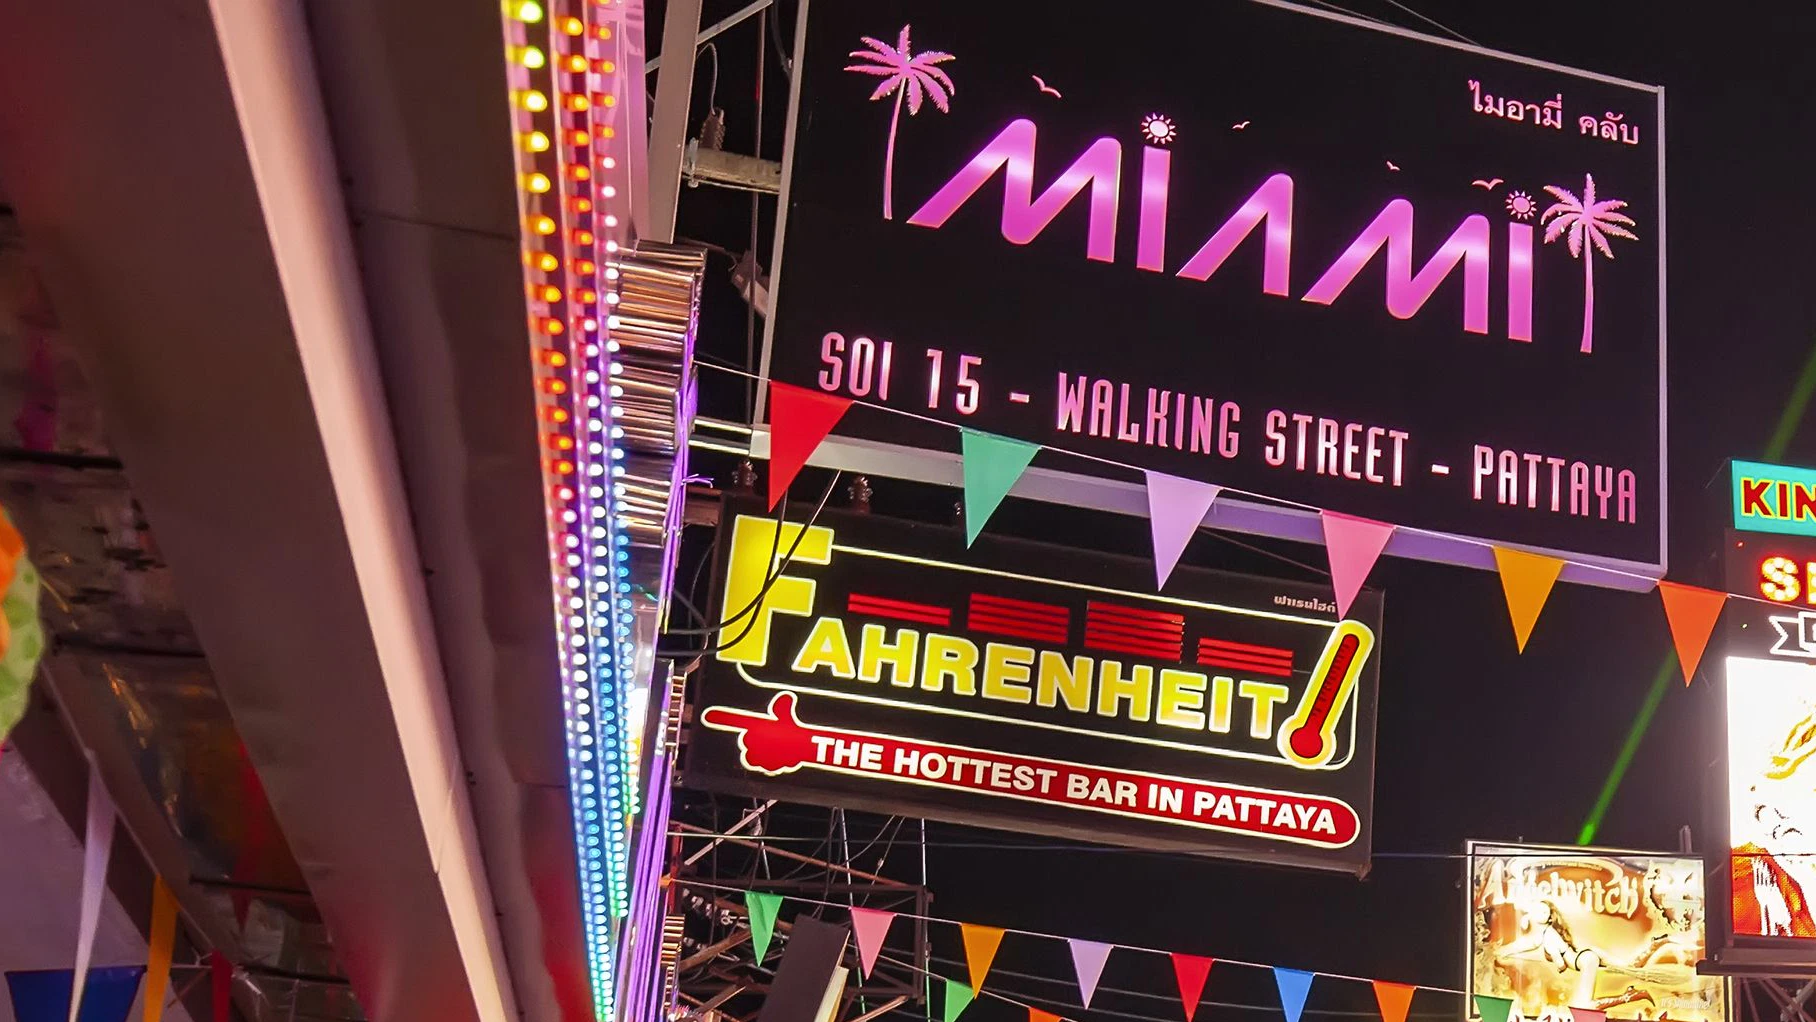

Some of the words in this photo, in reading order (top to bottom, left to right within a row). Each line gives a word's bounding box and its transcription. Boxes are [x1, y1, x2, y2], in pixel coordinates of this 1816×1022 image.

[1579, 108, 1640, 147] คลับ
[819, 332, 891, 401] SOI
[926, 348, 982, 415] 15
[1057, 371, 1241, 459] WALKING
[1265, 412, 1409, 488] STREET
[1472, 445, 1637, 525] PATTAYA
[811, 735, 883, 773] THE
[892, 748, 1058, 795] HOTTEST
[1066, 773, 1138, 808] BAR
[1148, 785, 1183, 814] IN
[1193, 789, 1337, 835] PATTAYA
